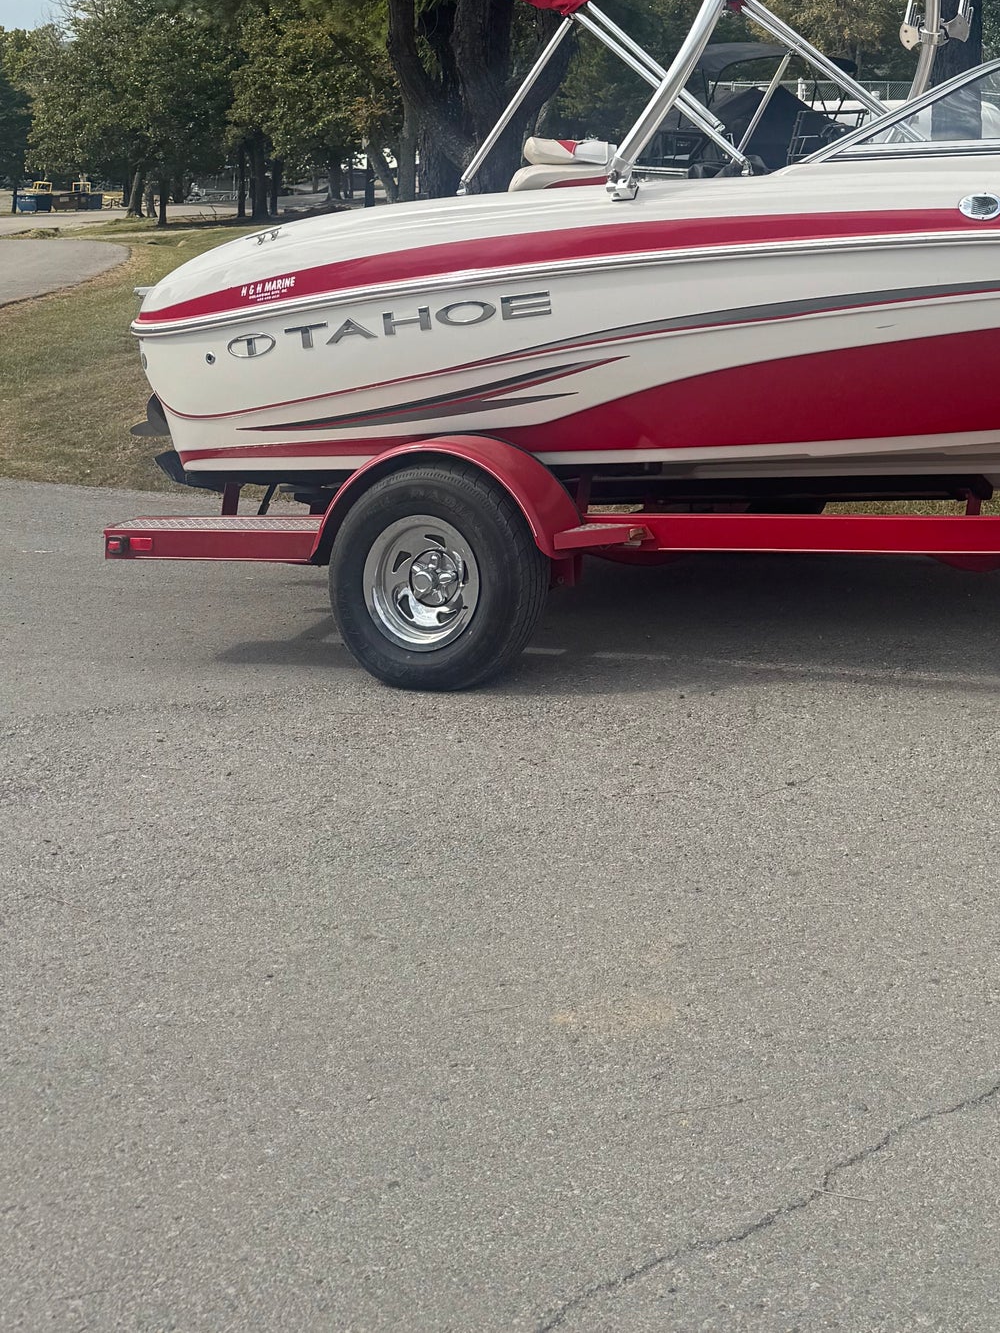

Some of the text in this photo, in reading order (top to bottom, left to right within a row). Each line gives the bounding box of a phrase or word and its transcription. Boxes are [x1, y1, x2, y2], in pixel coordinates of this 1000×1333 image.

[240, 286, 248, 297] H
[256, 283, 263, 294] H
[264, 276, 296, 293] MARINE
[284, 290, 552, 350] TAHOE
